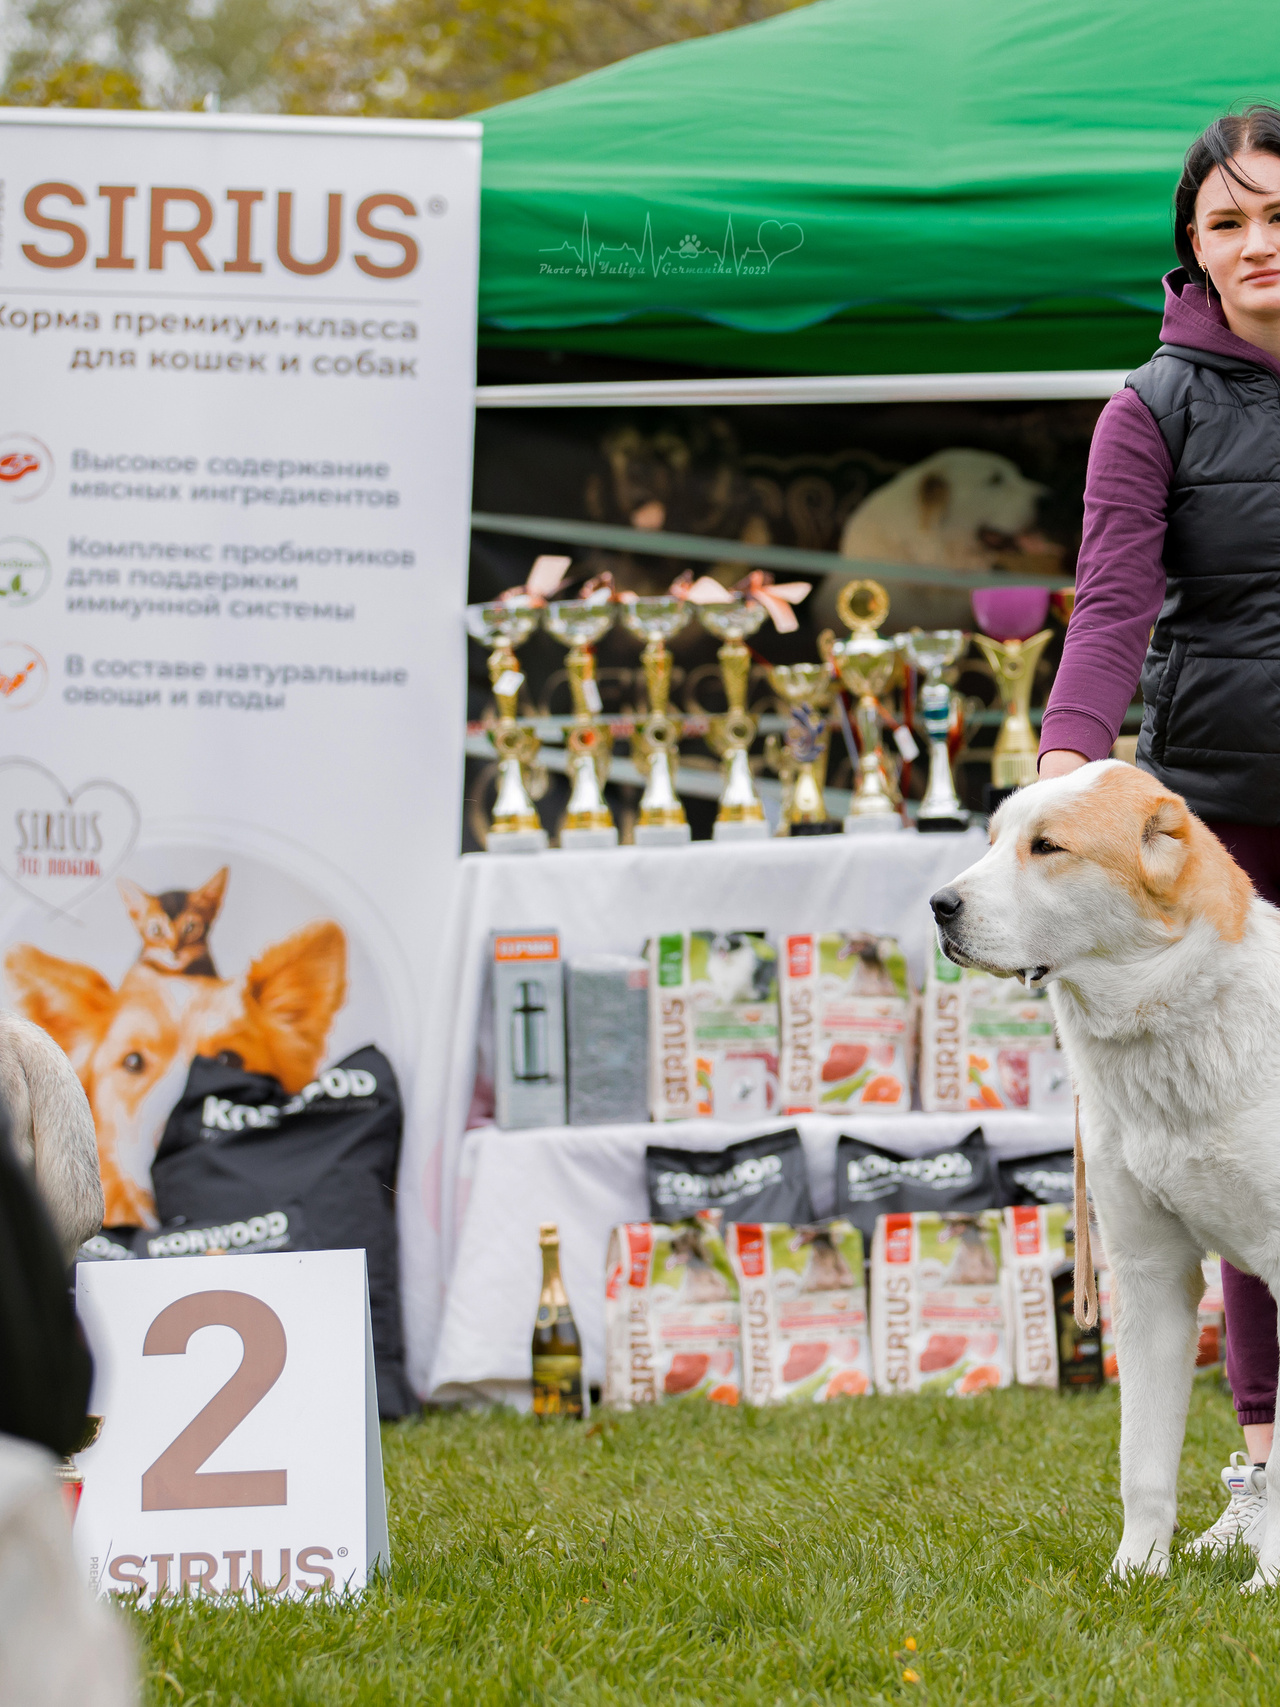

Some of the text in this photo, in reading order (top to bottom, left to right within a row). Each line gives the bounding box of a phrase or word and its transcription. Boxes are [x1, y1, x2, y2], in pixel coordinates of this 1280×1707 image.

[21, 182, 419, 279] SIRIUS
[69, 346, 418, 378] для кошек и собак
[113, 311, 418, 342] премиум-класса
[71, 449, 199, 475] Высокое
[65, 655, 84, 678] В
[663, 997, 689, 1104] SIRIUS
[936, 991, 960, 1100] SIRIUS
[886, 1276, 911, 1385] SIRIUS
[141, 1289, 288, 1512] 2
[108, 1546, 336, 1600] SIRIUS
